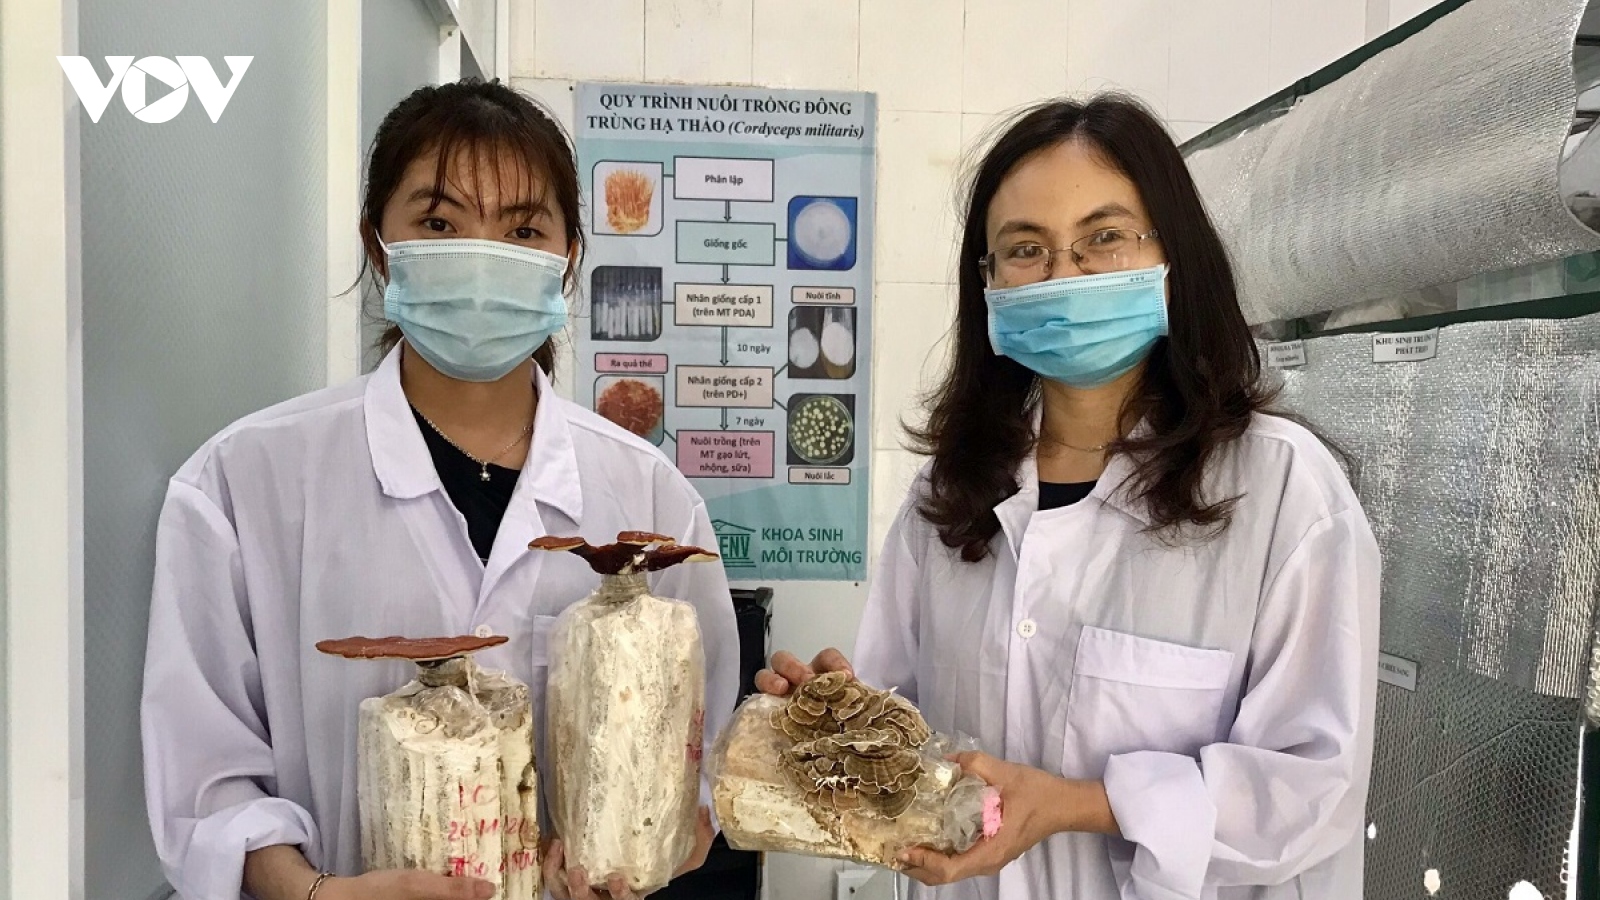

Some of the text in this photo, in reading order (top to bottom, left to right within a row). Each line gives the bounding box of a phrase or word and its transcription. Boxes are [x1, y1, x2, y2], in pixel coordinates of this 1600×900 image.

[600, 93, 636, 110] QUY
[640, 92, 693, 110] TRÌNH
[697, 94, 738, 111] NUÔI
[804, 97, 852, 115] ĐÔNG
[587, 112, 865, 140] TRÙNG HẠ THẢO (Cordyceps militaris)
[704, 174, 728, 183] Phân
[703, 238, 748, 250] Giống gốc
[686, 293, 762, 305] Nhân giống cấp 1
[692, 307, 756, 318] (trên MT PDA)
[736, 343, 772, 354] 10 ngày
[610, 359, 621, 367] Ra
[687, 375, 763, 387] Nhân giống cấp 2
[702, 389, 748, 400] (trên PD+)
[735, 416, 765, 427] 7 ngày
[690, 436, 761, 447] Nuôi trồng (trên
[699, 450, 715, 459] MT
[716, 452, 733, 460] gạo
[699, 463, 729, 474] nhộng,
[761, 528, 844, 542] KHOA SINH
[761, 547, 862, 564] MÔI TRƯỜNG
